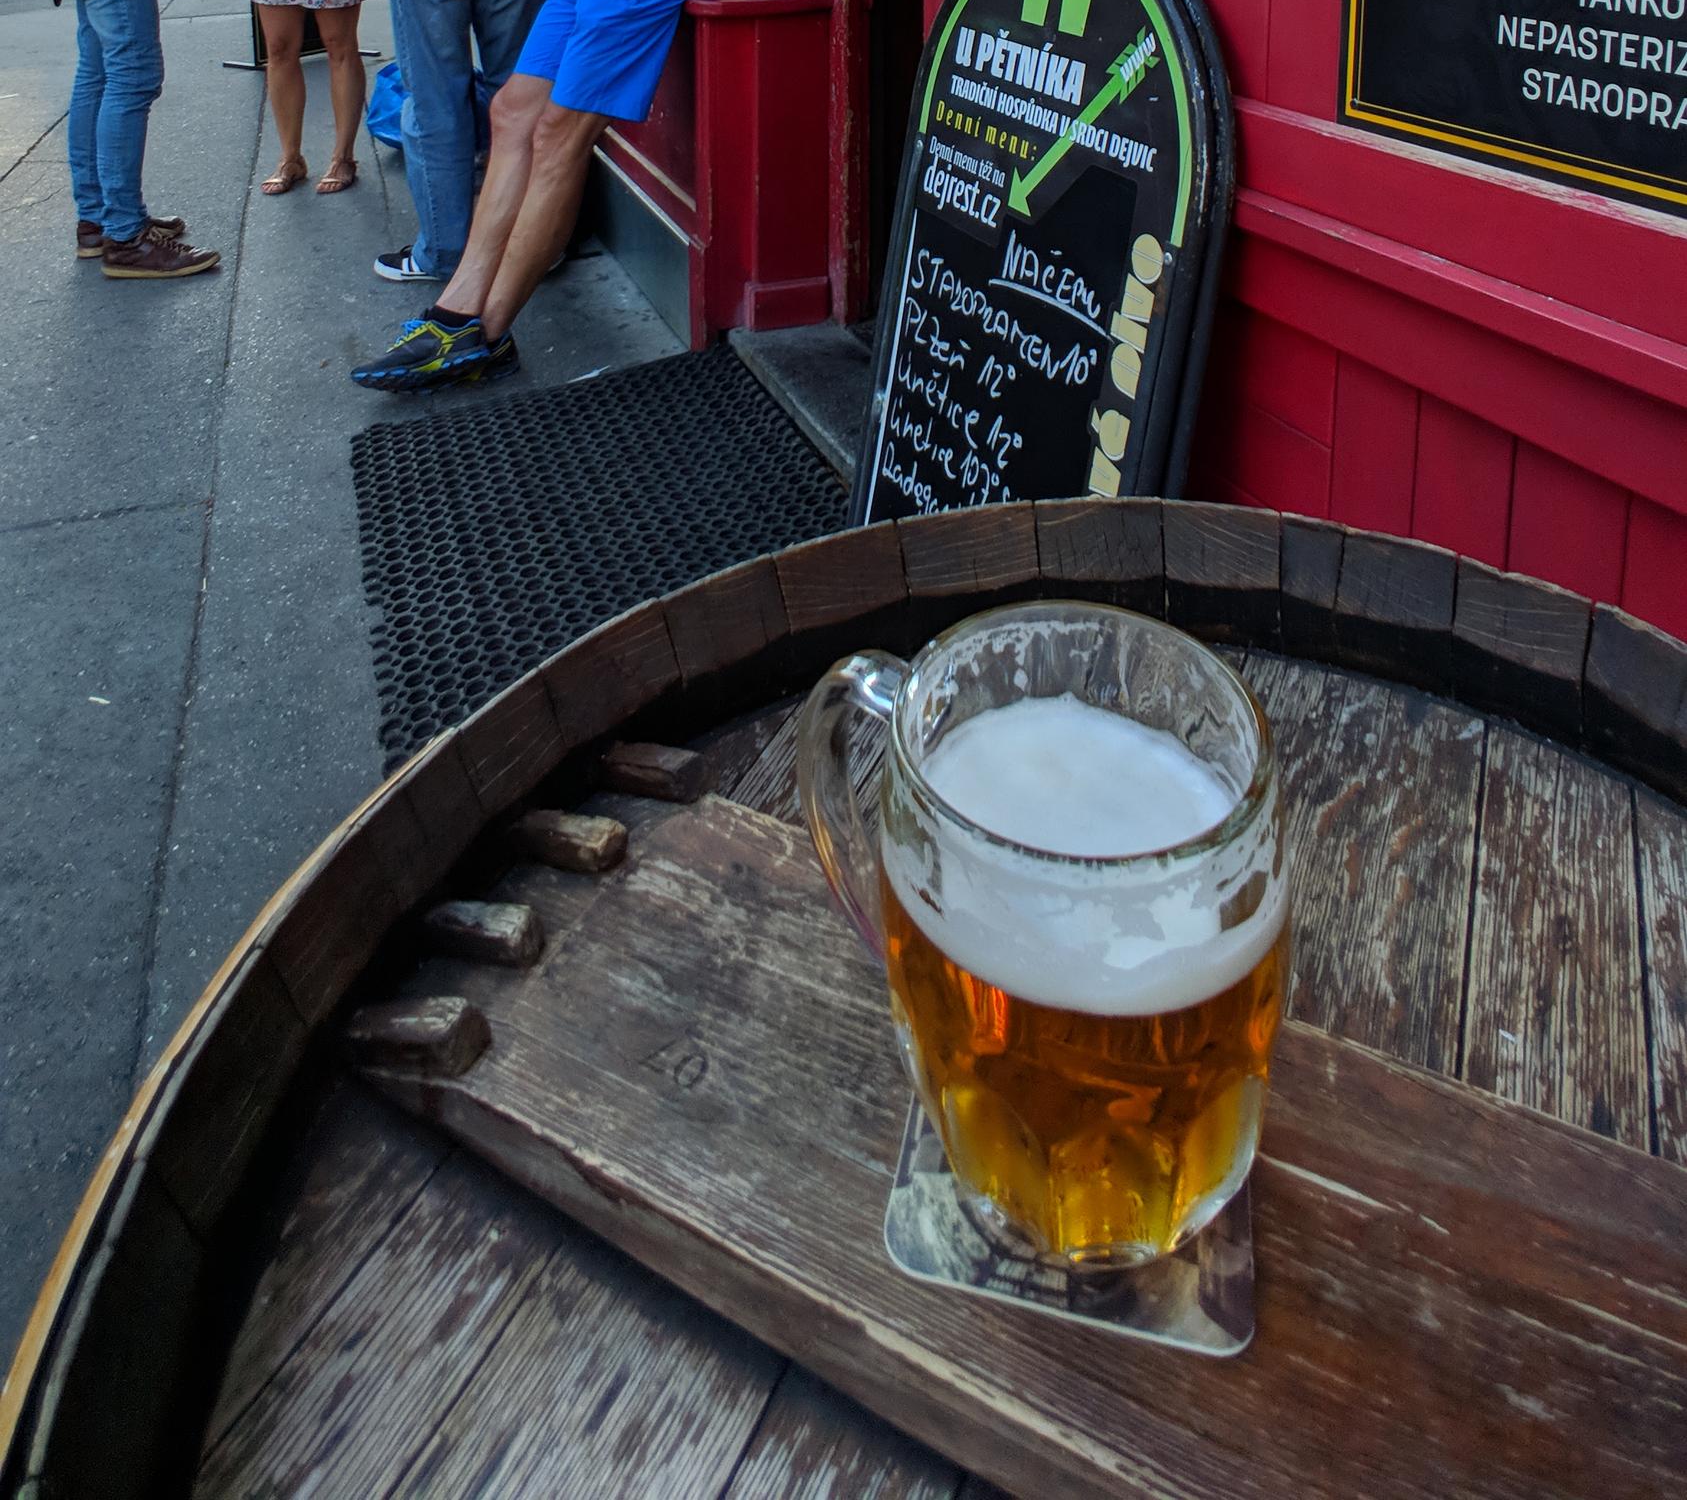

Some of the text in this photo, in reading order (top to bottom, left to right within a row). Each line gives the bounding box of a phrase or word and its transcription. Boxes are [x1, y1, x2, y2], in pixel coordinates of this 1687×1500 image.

[954, 25, 1087, 107] U PĚTNÍKA
[935, 99, 1038, 161] Denní menu:
[949, 73, 1158, 173] TRADIČNÍ HOSPŮDKA V SRDCI DEJVIC
[923, 155, 1002, 228] dejrest.cz
[929, 135, 956, 162] Denní
[953, 150, 979, 175] menu
[992, 171, 1006, 189] na
